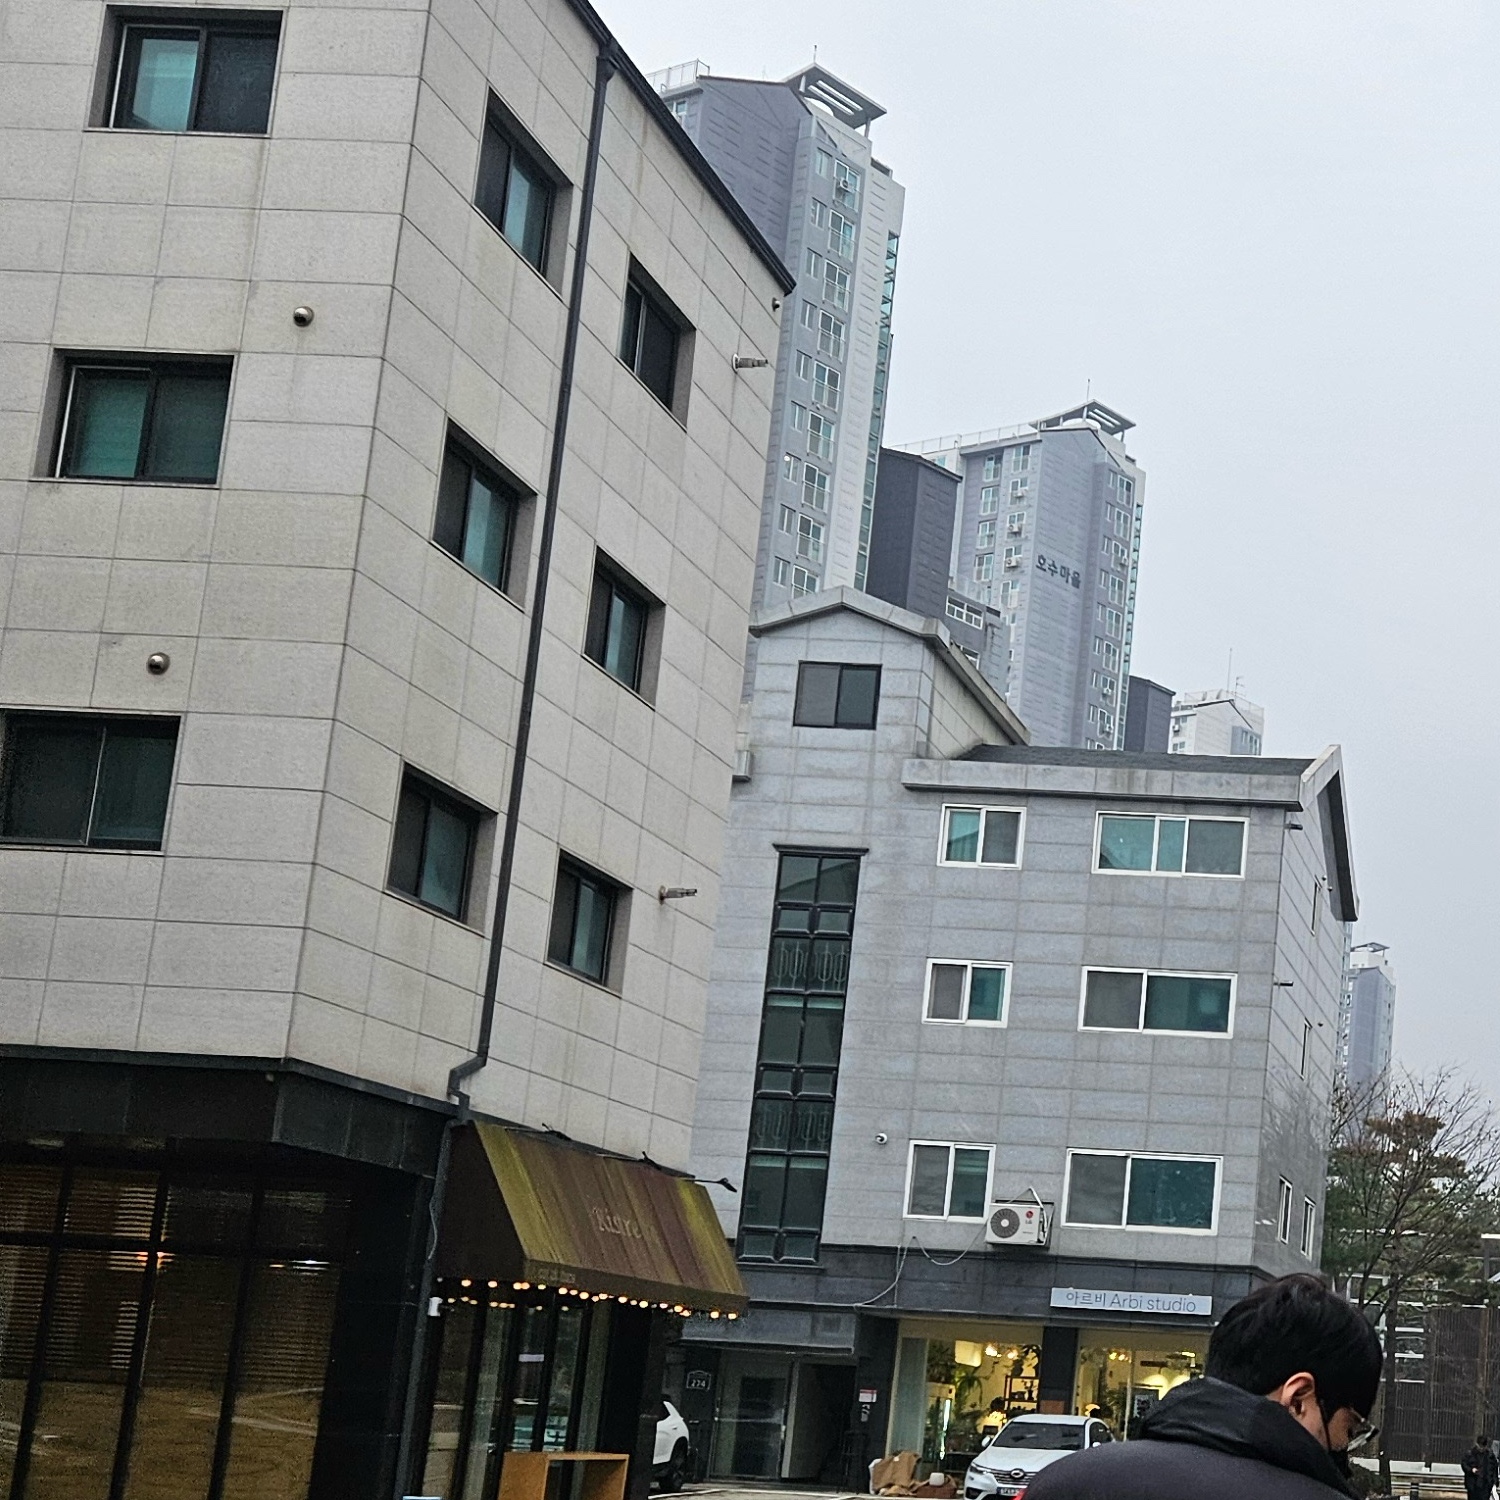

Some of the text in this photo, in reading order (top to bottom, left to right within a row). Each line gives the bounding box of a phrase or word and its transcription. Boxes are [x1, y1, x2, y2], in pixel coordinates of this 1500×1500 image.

[1035, 554, 1081, 590] 호수마을
[1066, 1291, 1197, 1313] 아르비 Arbi studio
